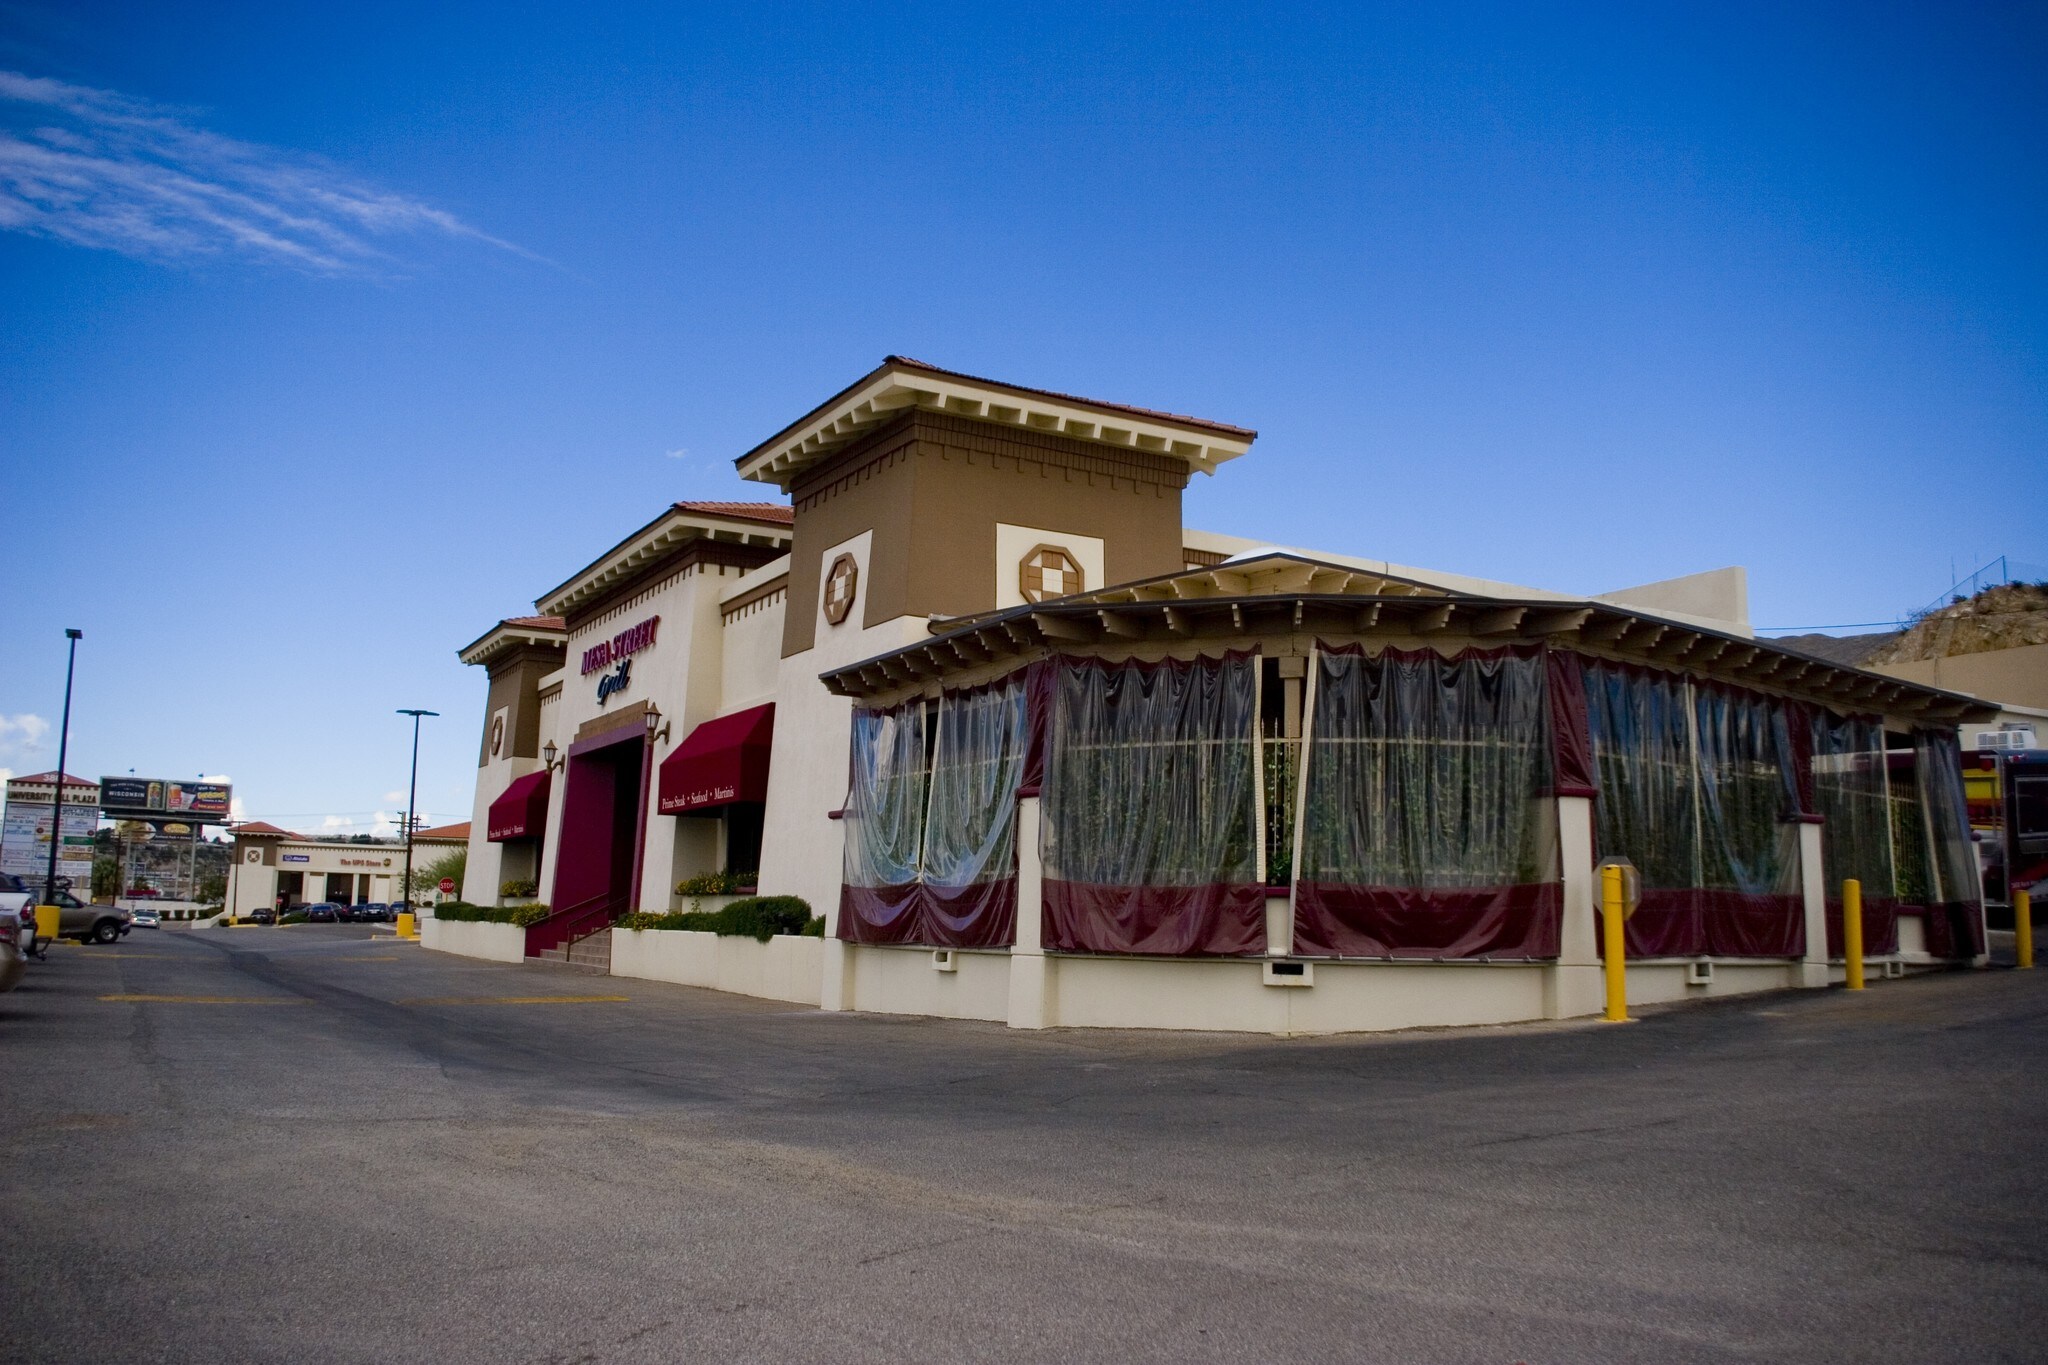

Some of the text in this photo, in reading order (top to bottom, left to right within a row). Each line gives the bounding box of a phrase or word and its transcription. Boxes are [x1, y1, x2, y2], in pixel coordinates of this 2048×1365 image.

[581, 615, 659, 675] MESA STREET
[597, 659, 632, 705] Grill
[8, 791, 52, 801] UNIVERSITY
[73, 794, 96, 803] PLAZA
[662, 785, 735, 809] Prime Steak Seafood Martinis
